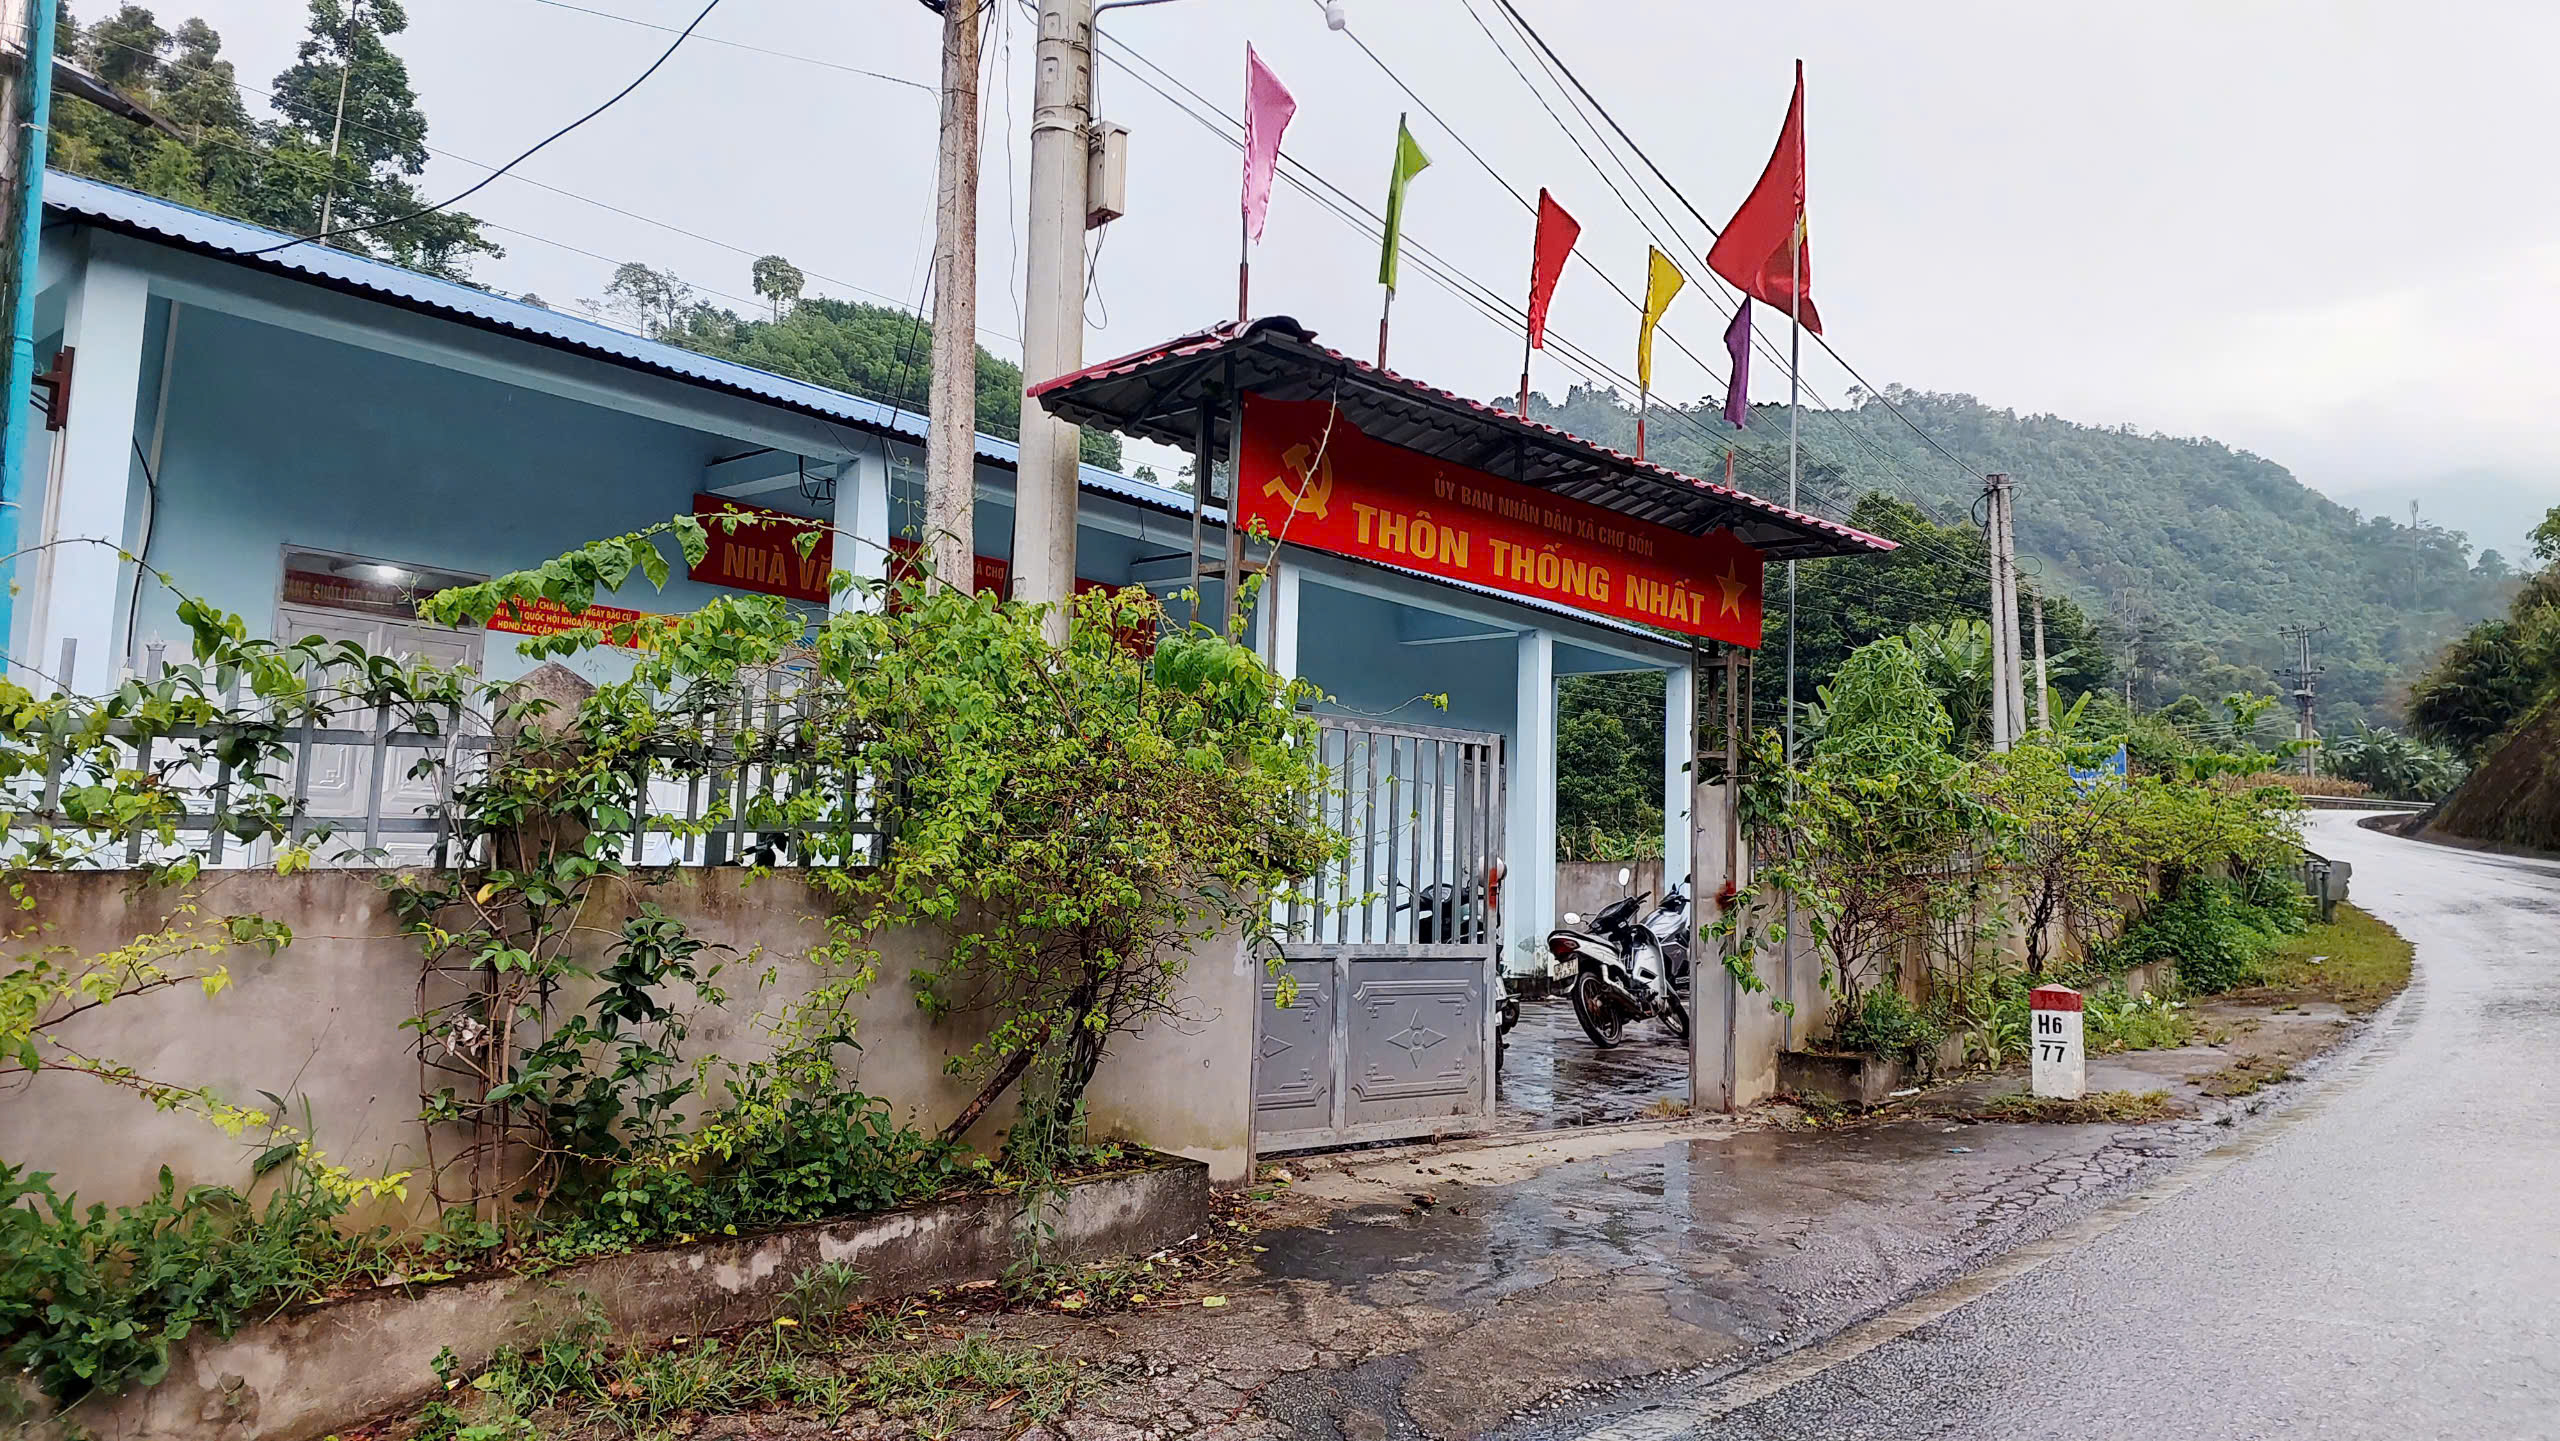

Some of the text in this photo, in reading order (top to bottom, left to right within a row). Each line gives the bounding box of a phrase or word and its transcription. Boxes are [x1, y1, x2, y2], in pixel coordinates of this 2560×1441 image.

[1434, 471, 1456, 501] ỦY
[1461, 486, 1493, 511] BAN
[1499, 497, 1540, 524] NHÂN
[1544, 508, 1573, 534] DÂN
[723, 542, 831, 595] NHÀ VĂ
[1352, 502, 1705, 625] THÔN THỐNG NHẤT
[524, 610, 545, 622] QUỐC
[497, 619, 521, 631] HĐND
[521, 622, 537, 634] CÁC
[2038, 1014, 2062, 1034] H6
[2040, 1044, 2065, 1063] 77
